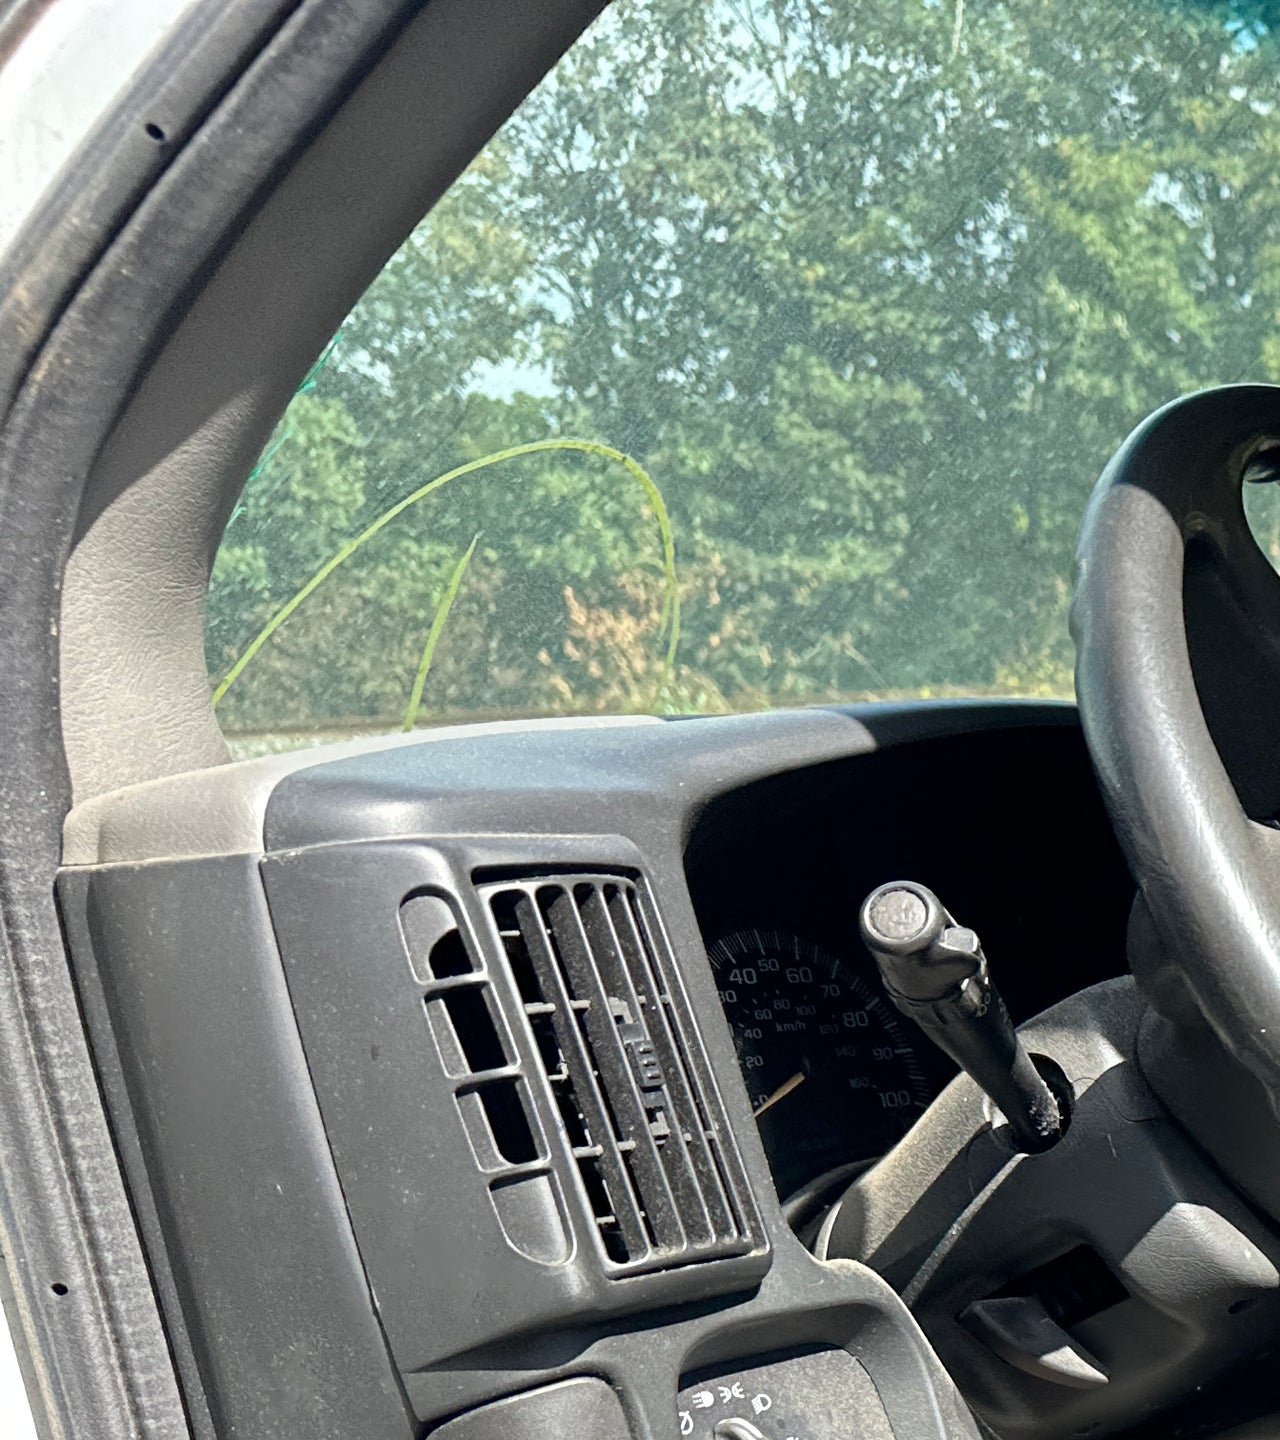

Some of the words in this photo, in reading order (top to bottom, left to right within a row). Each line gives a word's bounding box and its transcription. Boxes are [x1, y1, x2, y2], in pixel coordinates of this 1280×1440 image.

[758, 958, 780, 973] 50
[729, 967, 758, 985] 40
[786, 966, 813, 984] 60
[819, 983, 840, 998] 70
[773, 998, 791, 1010] 80
[754, 1008, 773, 1021] 60
[842, 1010, 869, 1028] 80
[775, 1018, 807, 1033] km/h
[743, 1027, 763, 1040] 40
[872, 1046, 894, 1061] 90
[878, 1089, 912, 1110] 100
